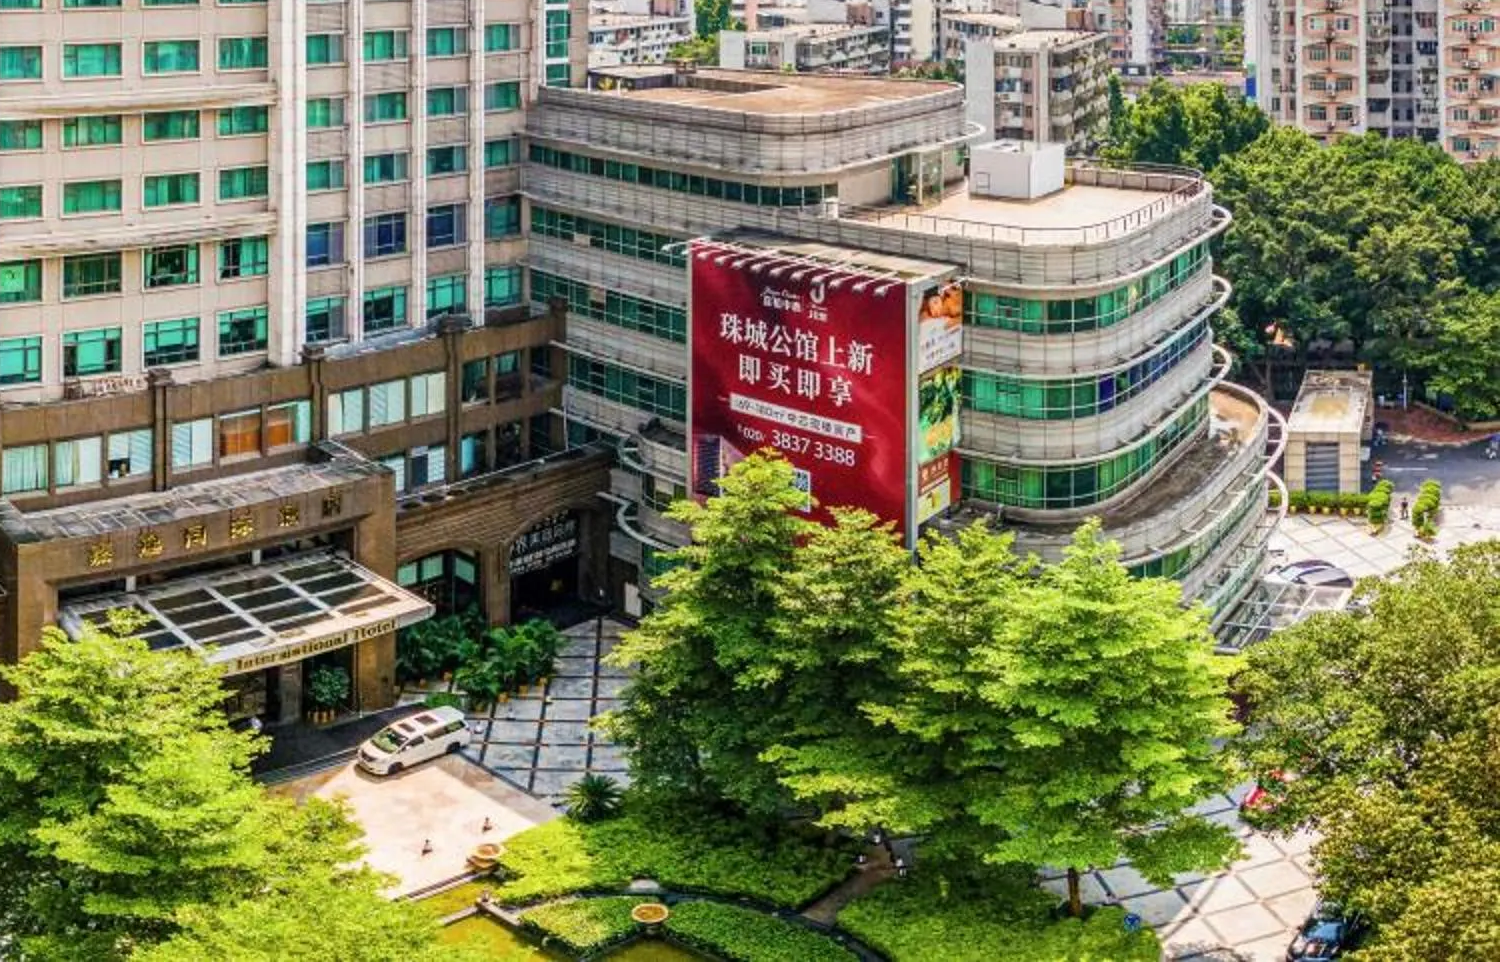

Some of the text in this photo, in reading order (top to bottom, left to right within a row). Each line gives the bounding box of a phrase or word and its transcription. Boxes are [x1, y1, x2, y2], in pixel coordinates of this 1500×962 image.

[719, 312, 874, 375] 珠城公馆上新
[739, 354, 852, 407] 即买即享
[771, 429, 810, 454] 3837
[814, 441, 855, 467] 3388
[354, 620, 395, 640] Hotel
